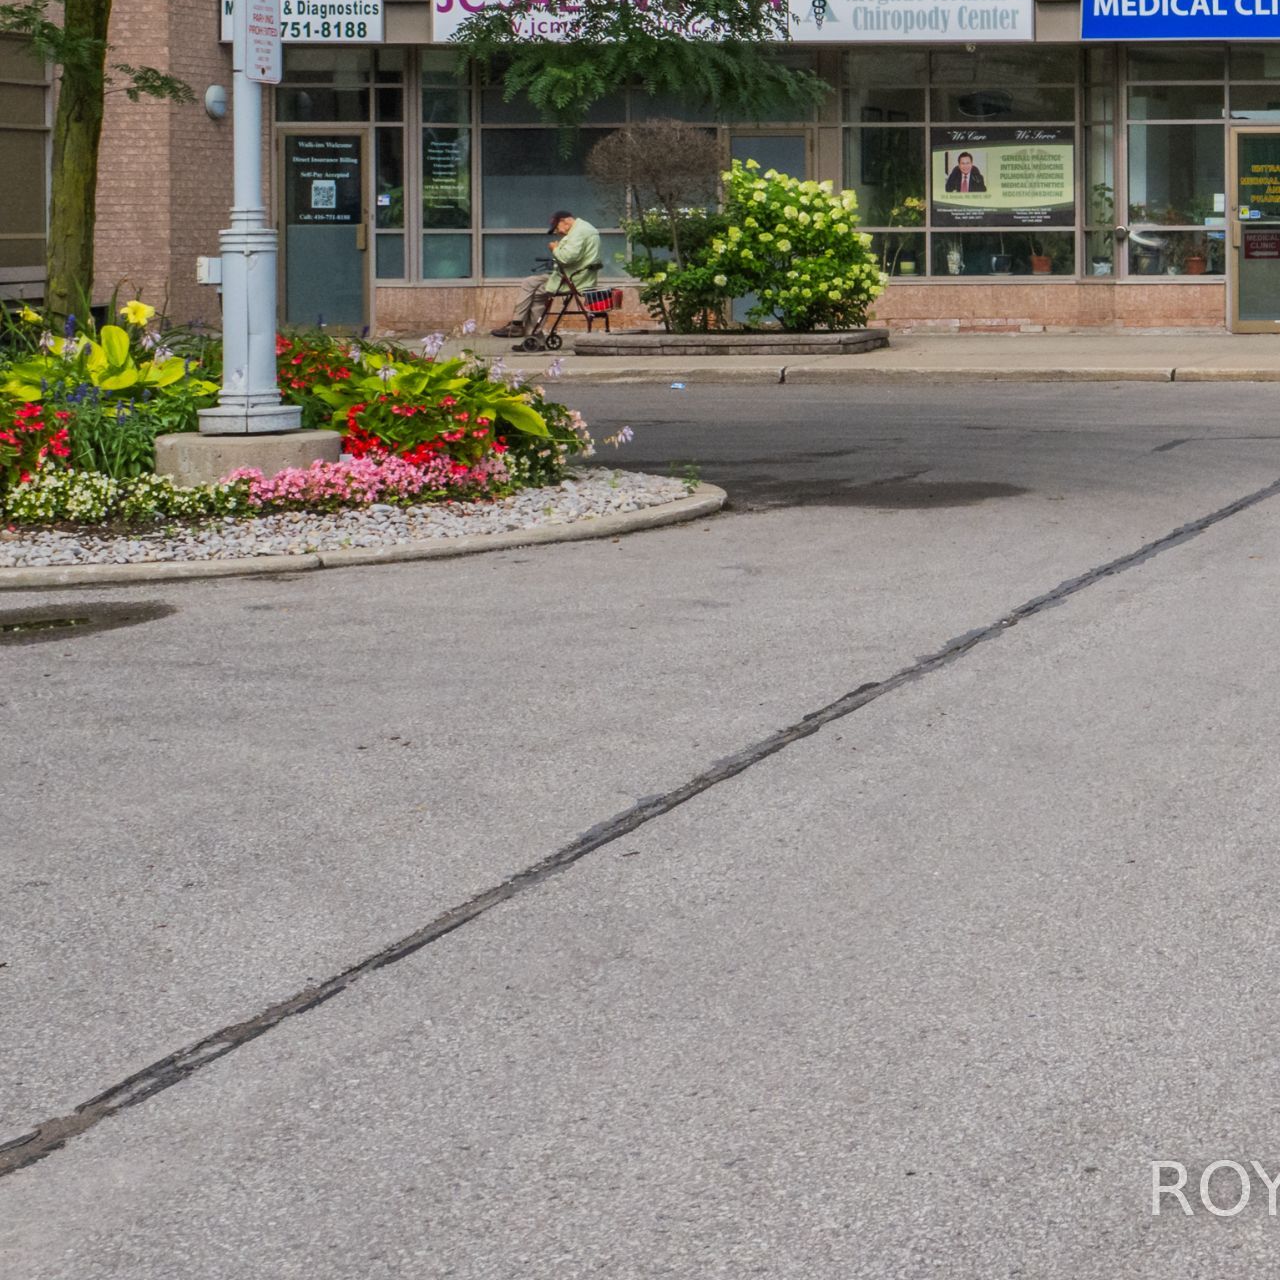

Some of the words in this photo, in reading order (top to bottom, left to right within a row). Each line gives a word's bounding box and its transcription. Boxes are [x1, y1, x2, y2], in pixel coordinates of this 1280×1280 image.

[283, 0, 293, 15] &
[297, 1, 379, 19] Diagnostics
[852, 6, 951, 34] Chiropody
[957, 6, 1019, 31] Center
[1246, 233, 1280, 241] MEDICAL
